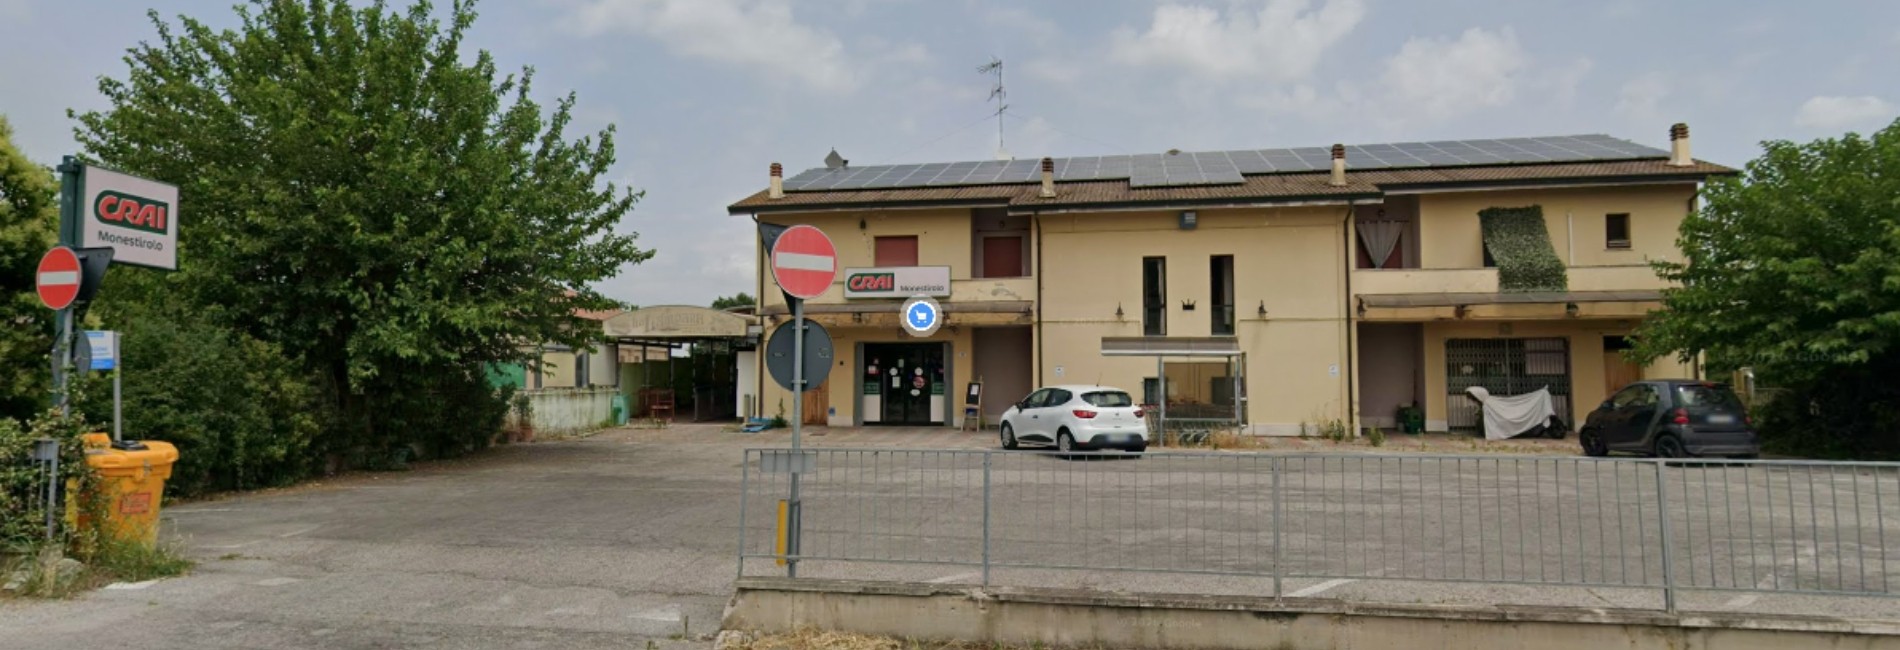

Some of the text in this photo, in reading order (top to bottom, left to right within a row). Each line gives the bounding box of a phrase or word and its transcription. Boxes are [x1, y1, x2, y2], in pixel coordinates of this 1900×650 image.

[98, 195, 165, 230] CRAI
[98, 231, 163, 251] Monestirolo
[849, 275, 893, 290] CRAI
